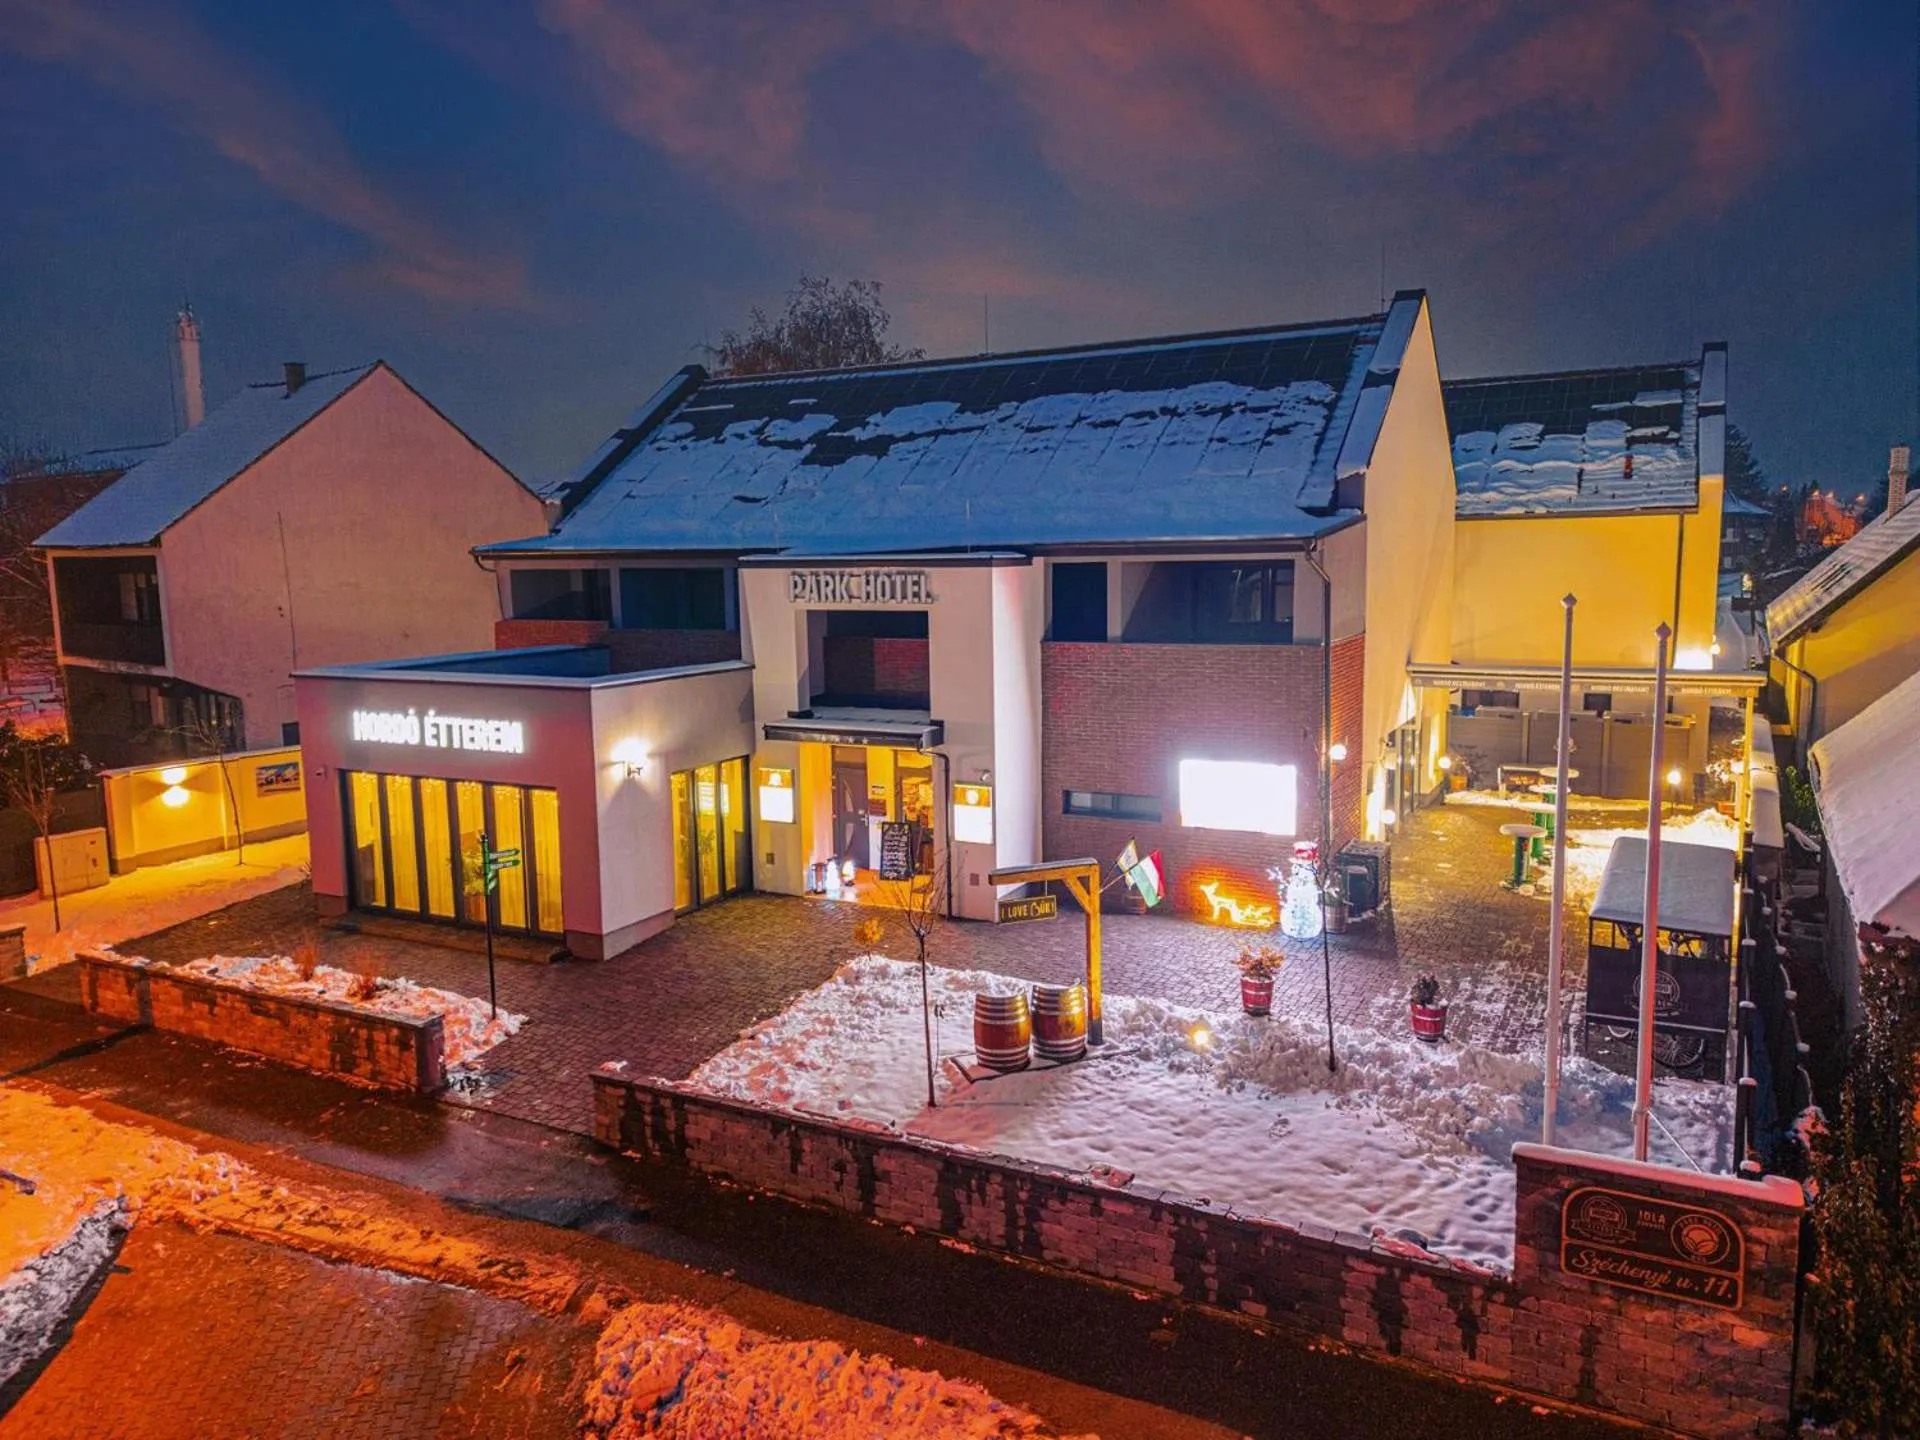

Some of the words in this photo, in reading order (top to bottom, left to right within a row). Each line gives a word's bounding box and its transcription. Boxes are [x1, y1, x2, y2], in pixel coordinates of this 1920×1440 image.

[789, 570, 852, 603] PARK
[860, 571, 933, 604] HOTEL
[1008, 905, 1028, 919] LOVE
